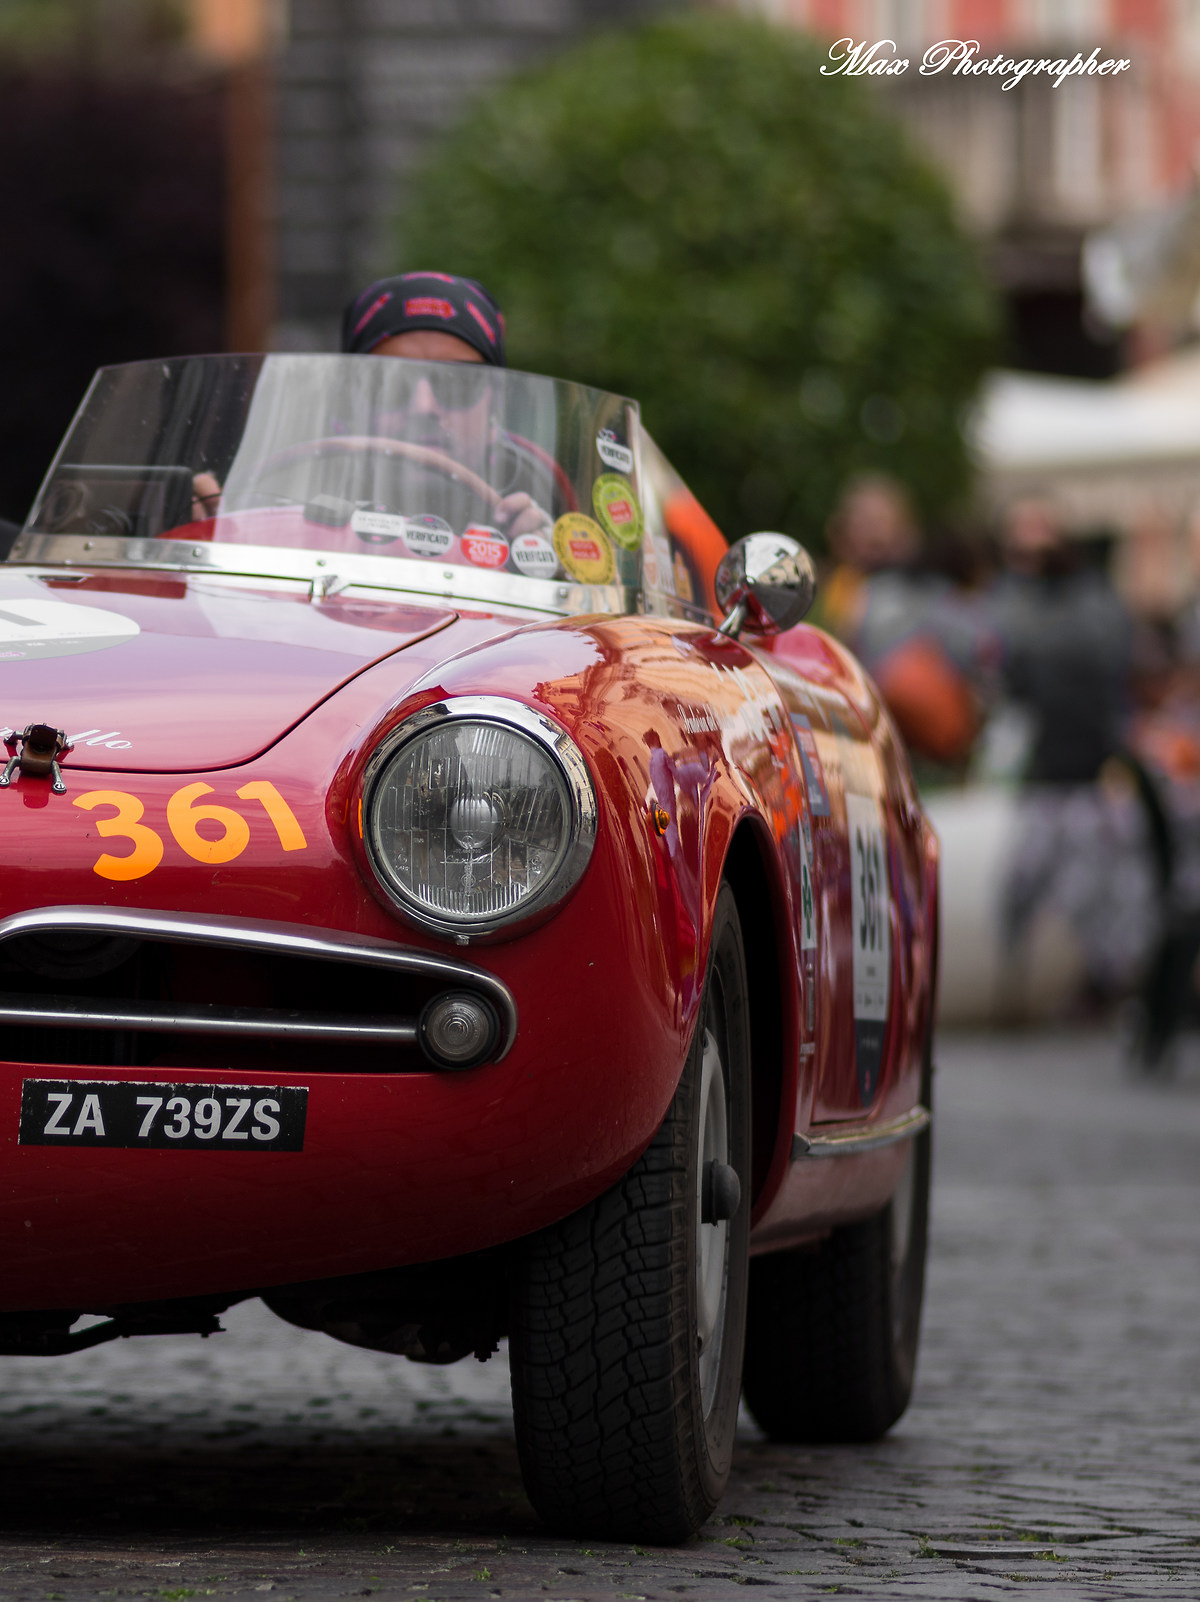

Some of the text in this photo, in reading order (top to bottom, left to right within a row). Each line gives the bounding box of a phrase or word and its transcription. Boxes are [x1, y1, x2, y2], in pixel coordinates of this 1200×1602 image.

[406, 529, 449, 546] VERIFICATO
[468, 540, 501, 558] 2015
[516, 550, 555, 564] VERIFICATO
[72, 780, 308, 881] 361
[43, 1092, 281, 1142] ZA 739ZS
